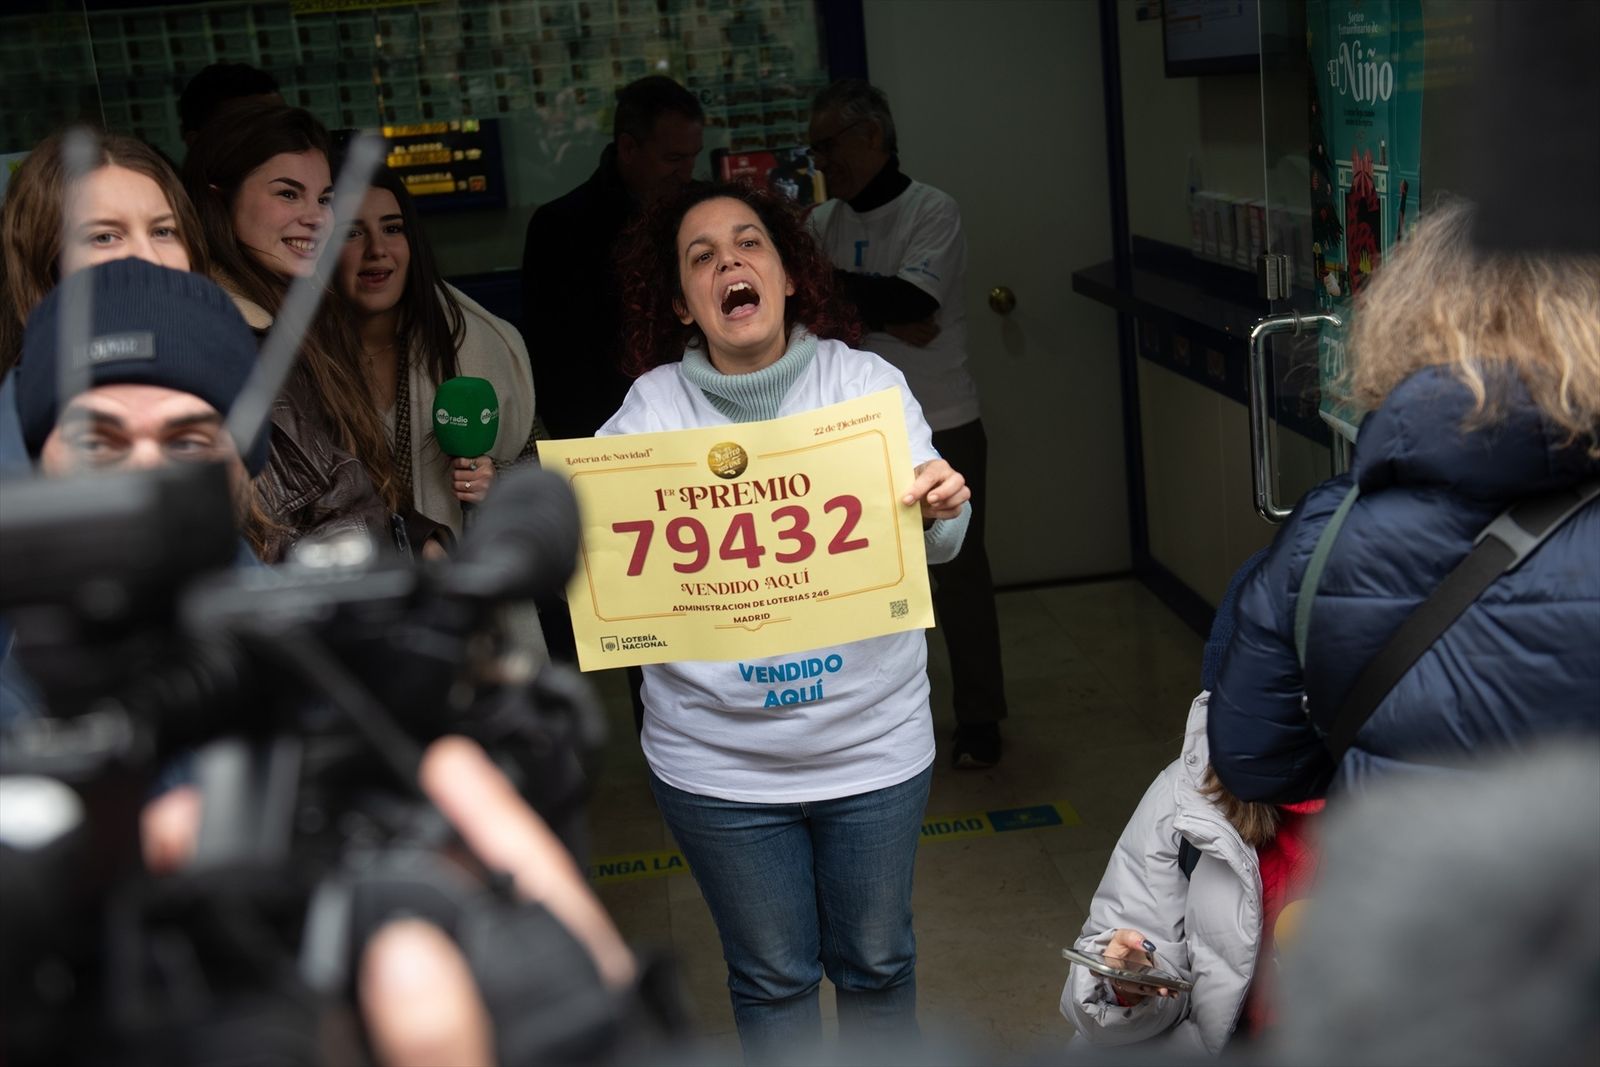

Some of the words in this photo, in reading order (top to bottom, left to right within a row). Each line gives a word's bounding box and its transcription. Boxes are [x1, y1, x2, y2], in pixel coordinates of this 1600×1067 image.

[1327, 58, 1340, 88] El
[1339, 40, 1394, 106] Niño
[450, 416, 468, 424] radio
[601, 454, 612, 462] de
[679, 473, 811, 510] PREMIO
[612, 494, 869, 577] 79432
[681, 579, 759, 596] VENDIDO
[765, 568, 810, 590] AQUÍ
[672, 602, 751, 612] ADMINISTRACION
[752, 600, 765, 608] DE
[766, 594, 810, 606] LOTERIAS
[811, 588, 830, 599] 246
[733, 612, 771, 624] MADRID
[622, 641, 669, 650] NACIONAL
[738, 654, 843, 683] VENDIDO
[764, 678, 824, 708] AQUÍ
[653, 855, 683, 870] LA
